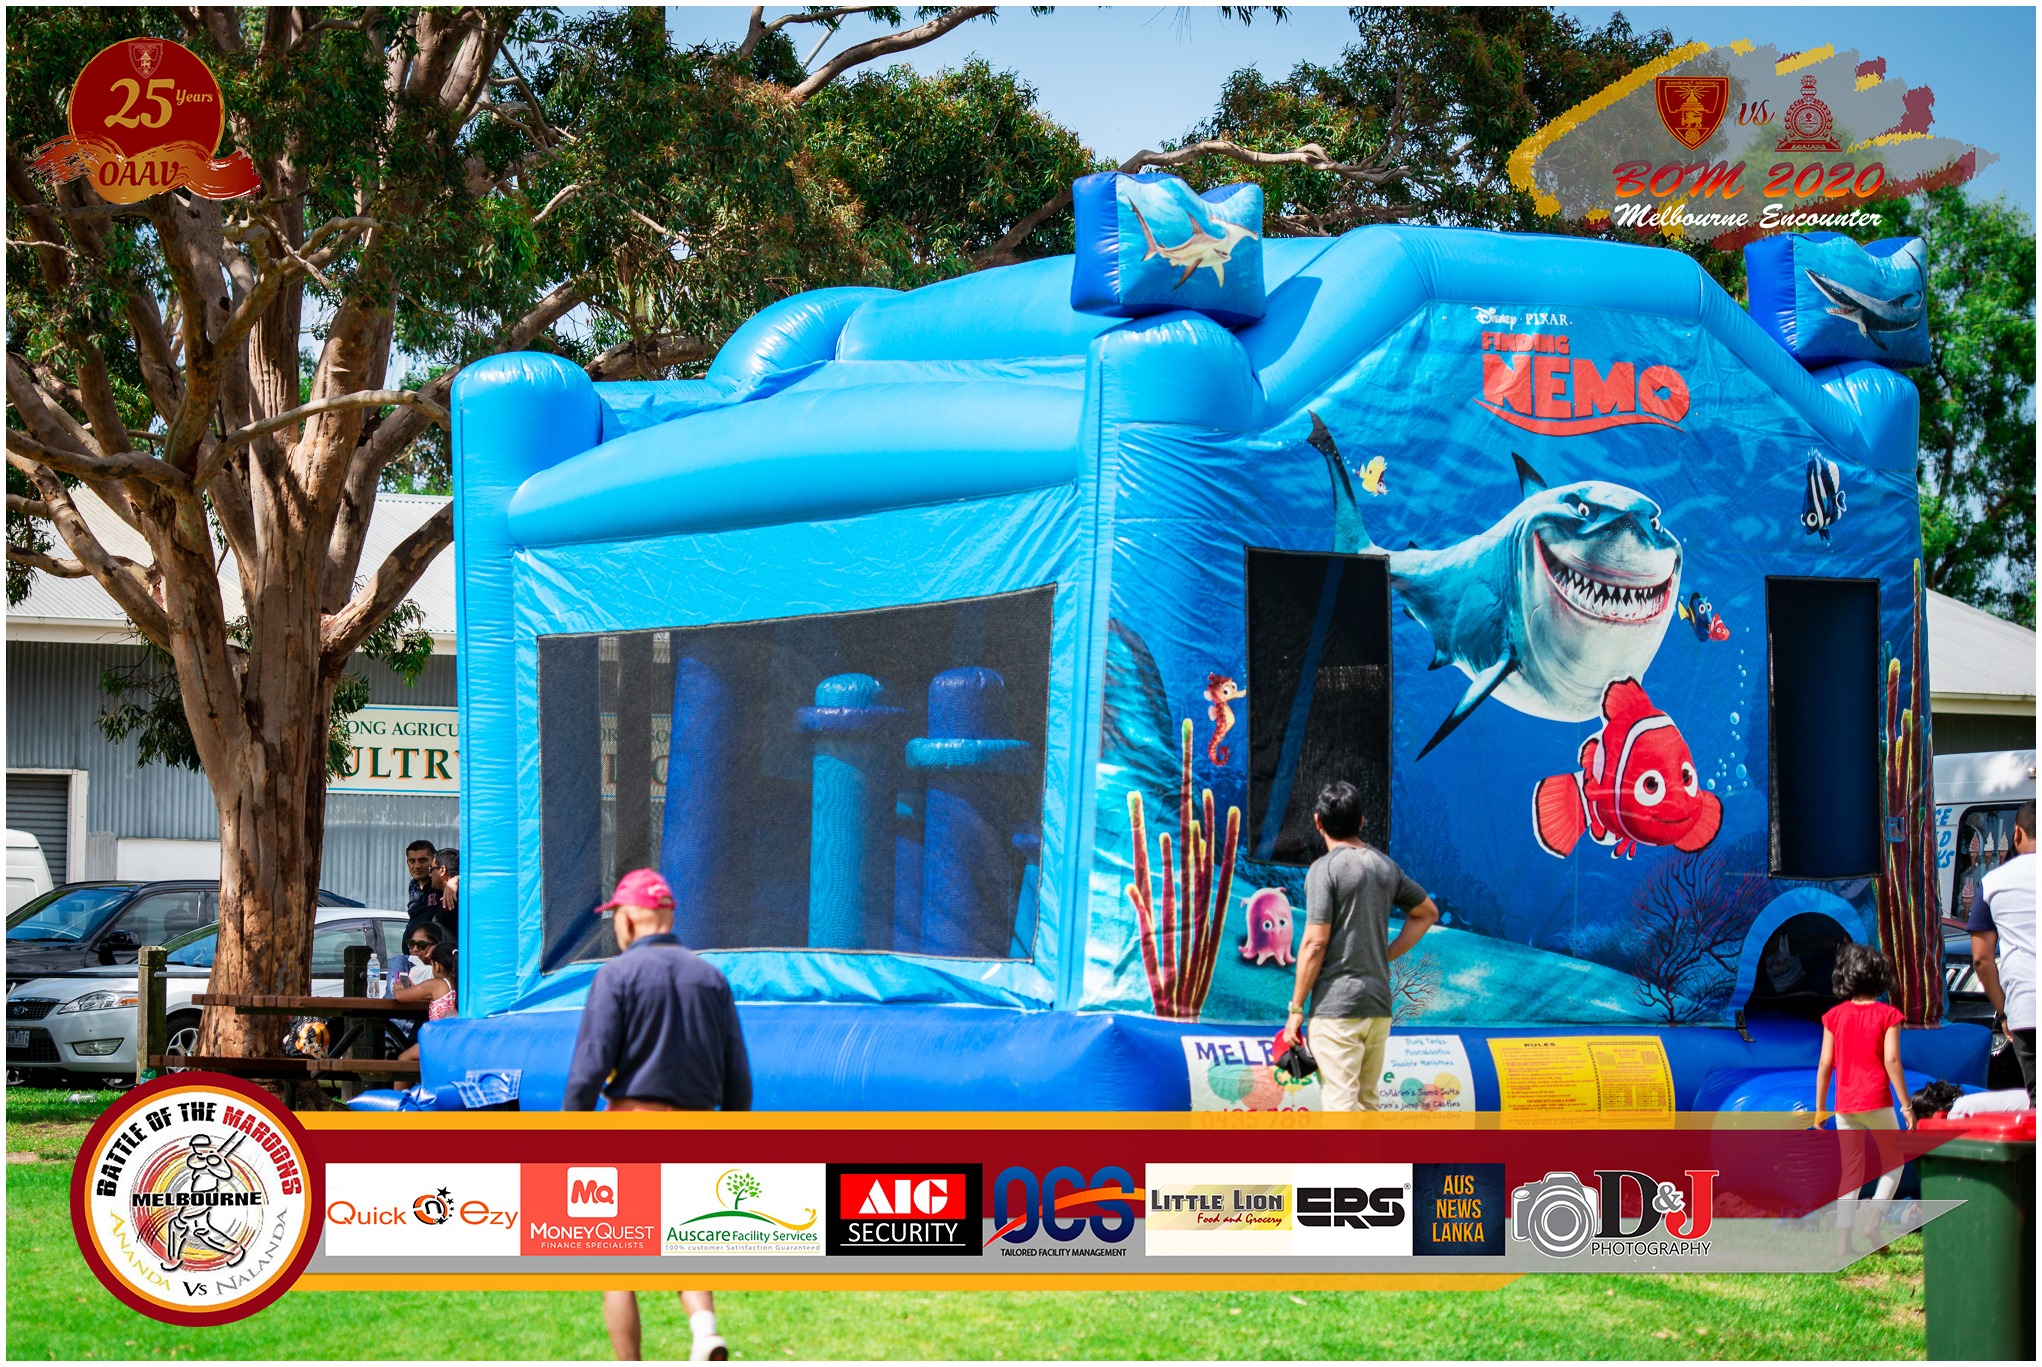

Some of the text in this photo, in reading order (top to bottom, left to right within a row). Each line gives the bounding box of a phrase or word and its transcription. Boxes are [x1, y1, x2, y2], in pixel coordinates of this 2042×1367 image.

[1525, 313, 1569, 326] PIXAR
[1481, 331, 1570, 355] FINDING
[1482, 353, 1691, 423] NEMO
